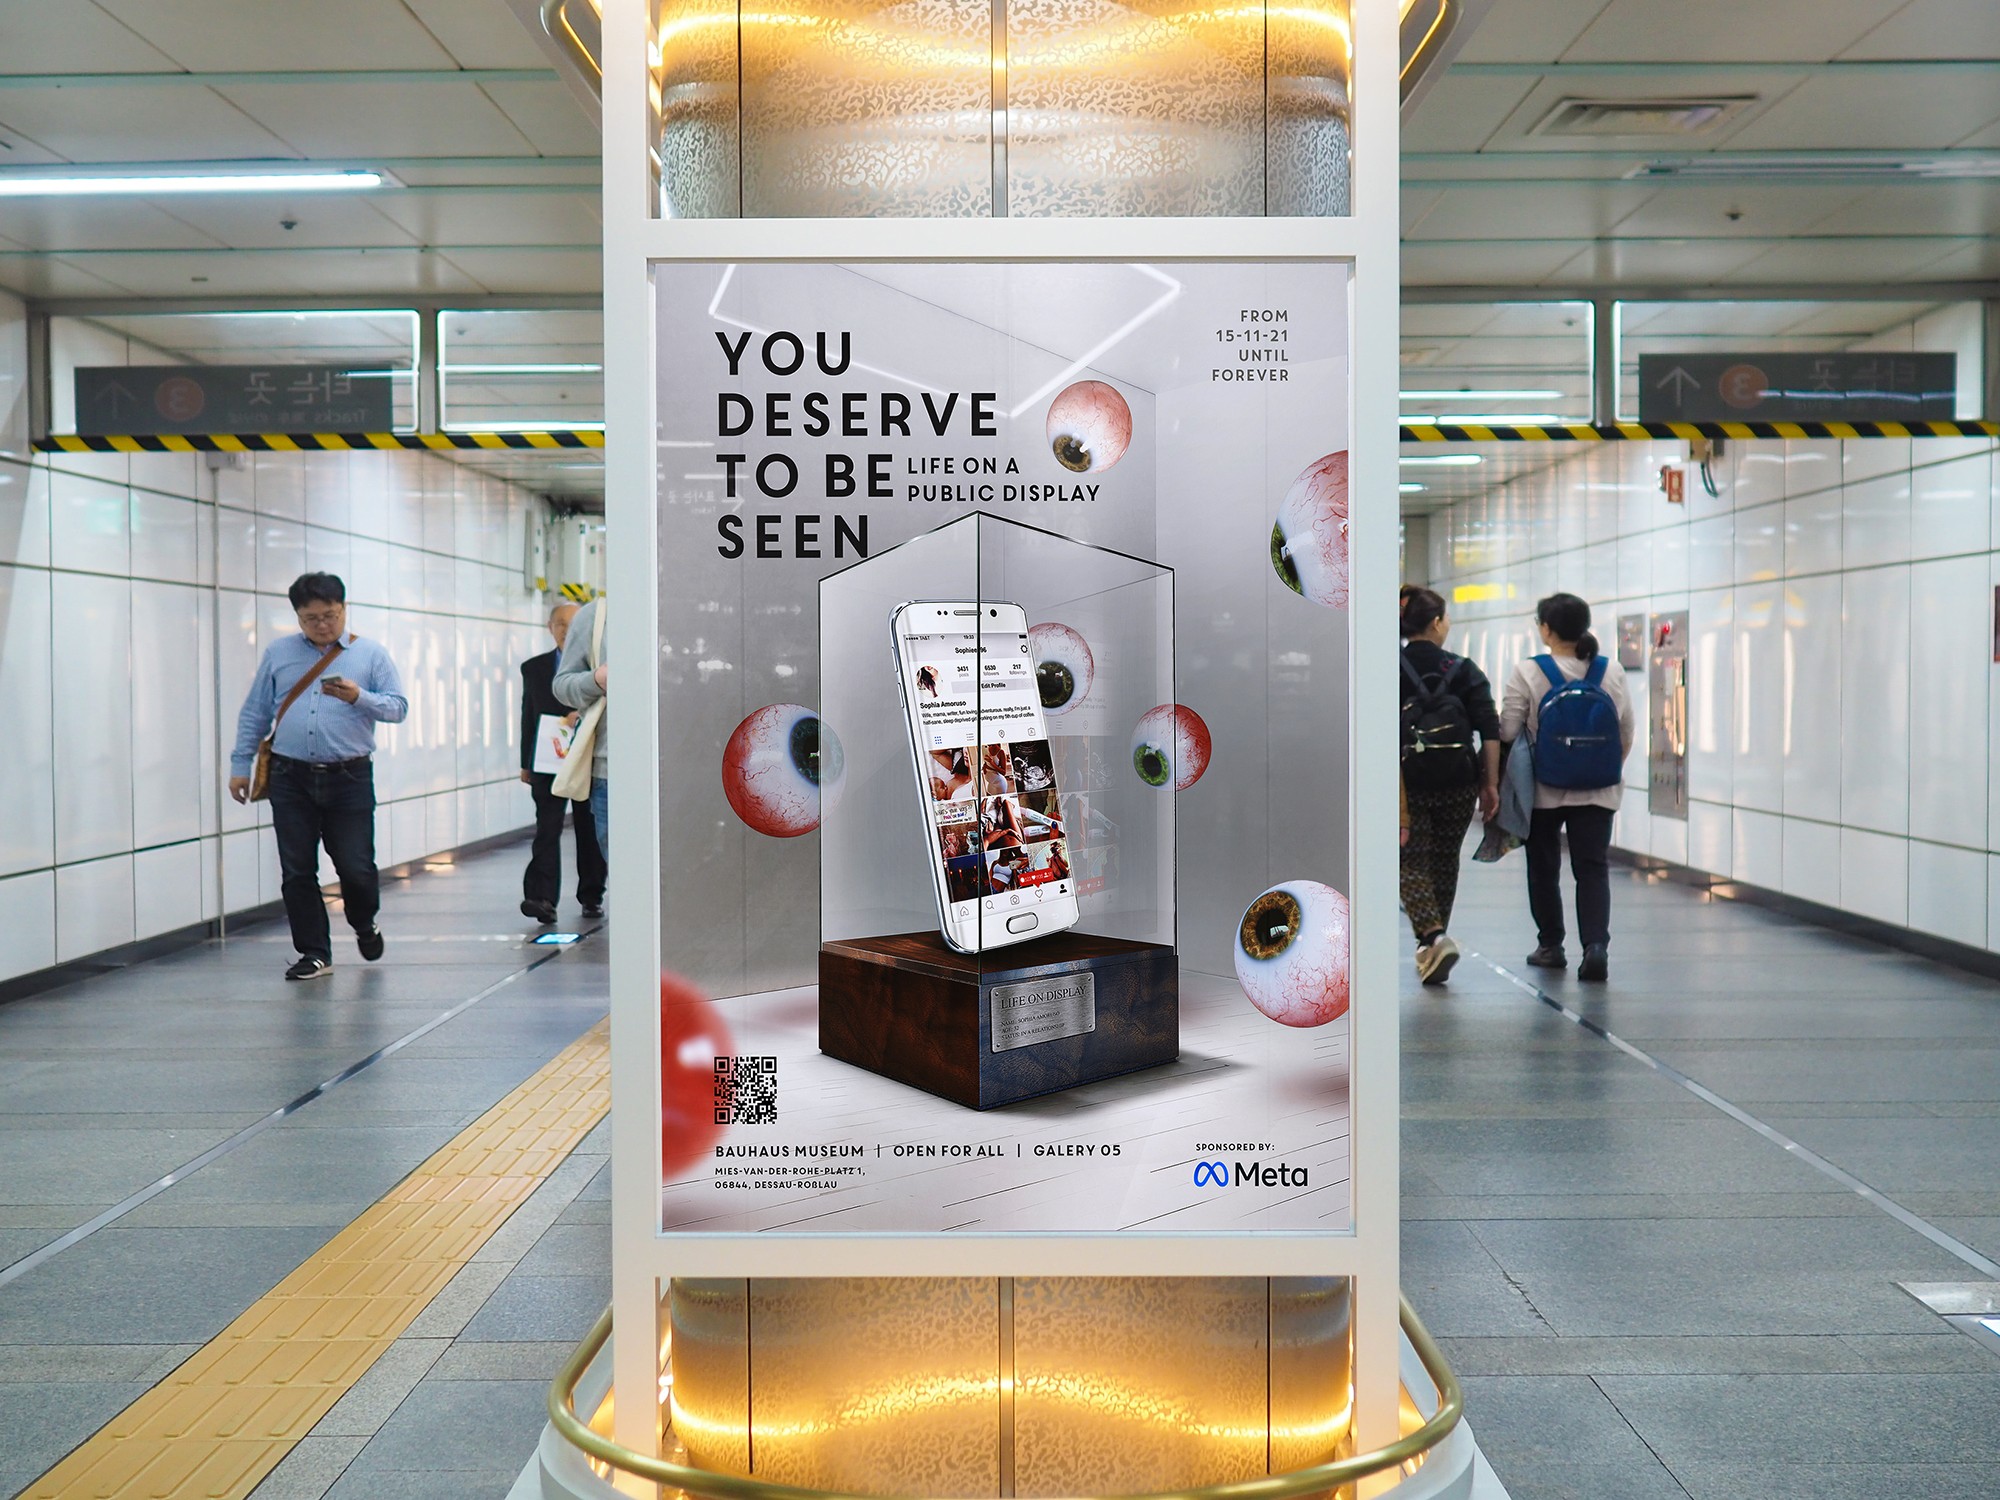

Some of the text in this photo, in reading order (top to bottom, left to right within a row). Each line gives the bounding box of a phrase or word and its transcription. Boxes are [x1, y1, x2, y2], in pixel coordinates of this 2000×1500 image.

[1241, 309, 1289, 322] FROM
[1216, 329, 1288, 342] 15-11-21
[714, 331, 851, 376] YOU
[1239, 349, 1289, 362] UNTIL
[1212, 369, 1289, 382] FOREVER
[718, 392, 997, 437] DESERVE
[908, 457, 1021, 475] LIFE ON A
[716, 453, 894, 498] TO BE
[908, 484, 1100, 502] PUBLIC DISPLAY
[717, 514, 869, 559] SEEN
[1001, 985, 1087, 1009] LIFE ON DISPLAY
[715, 1145, 864, 1158] BAUHAUS MUSEUM
[893, 1145, 1005, 1157] OPEN FOR ALL
[1033, 1144, 1121, 1157] GALERY 05
[1195, 1143, 1275, 1152] SPONSORED BY:
[714, 1167, 866, 1177] MIES-VAN-DER-ROHE-PLATZ 1,
[1234, 1161, 1309, 1188] Meta
[714, 1181, 751, 1190] 06844,
